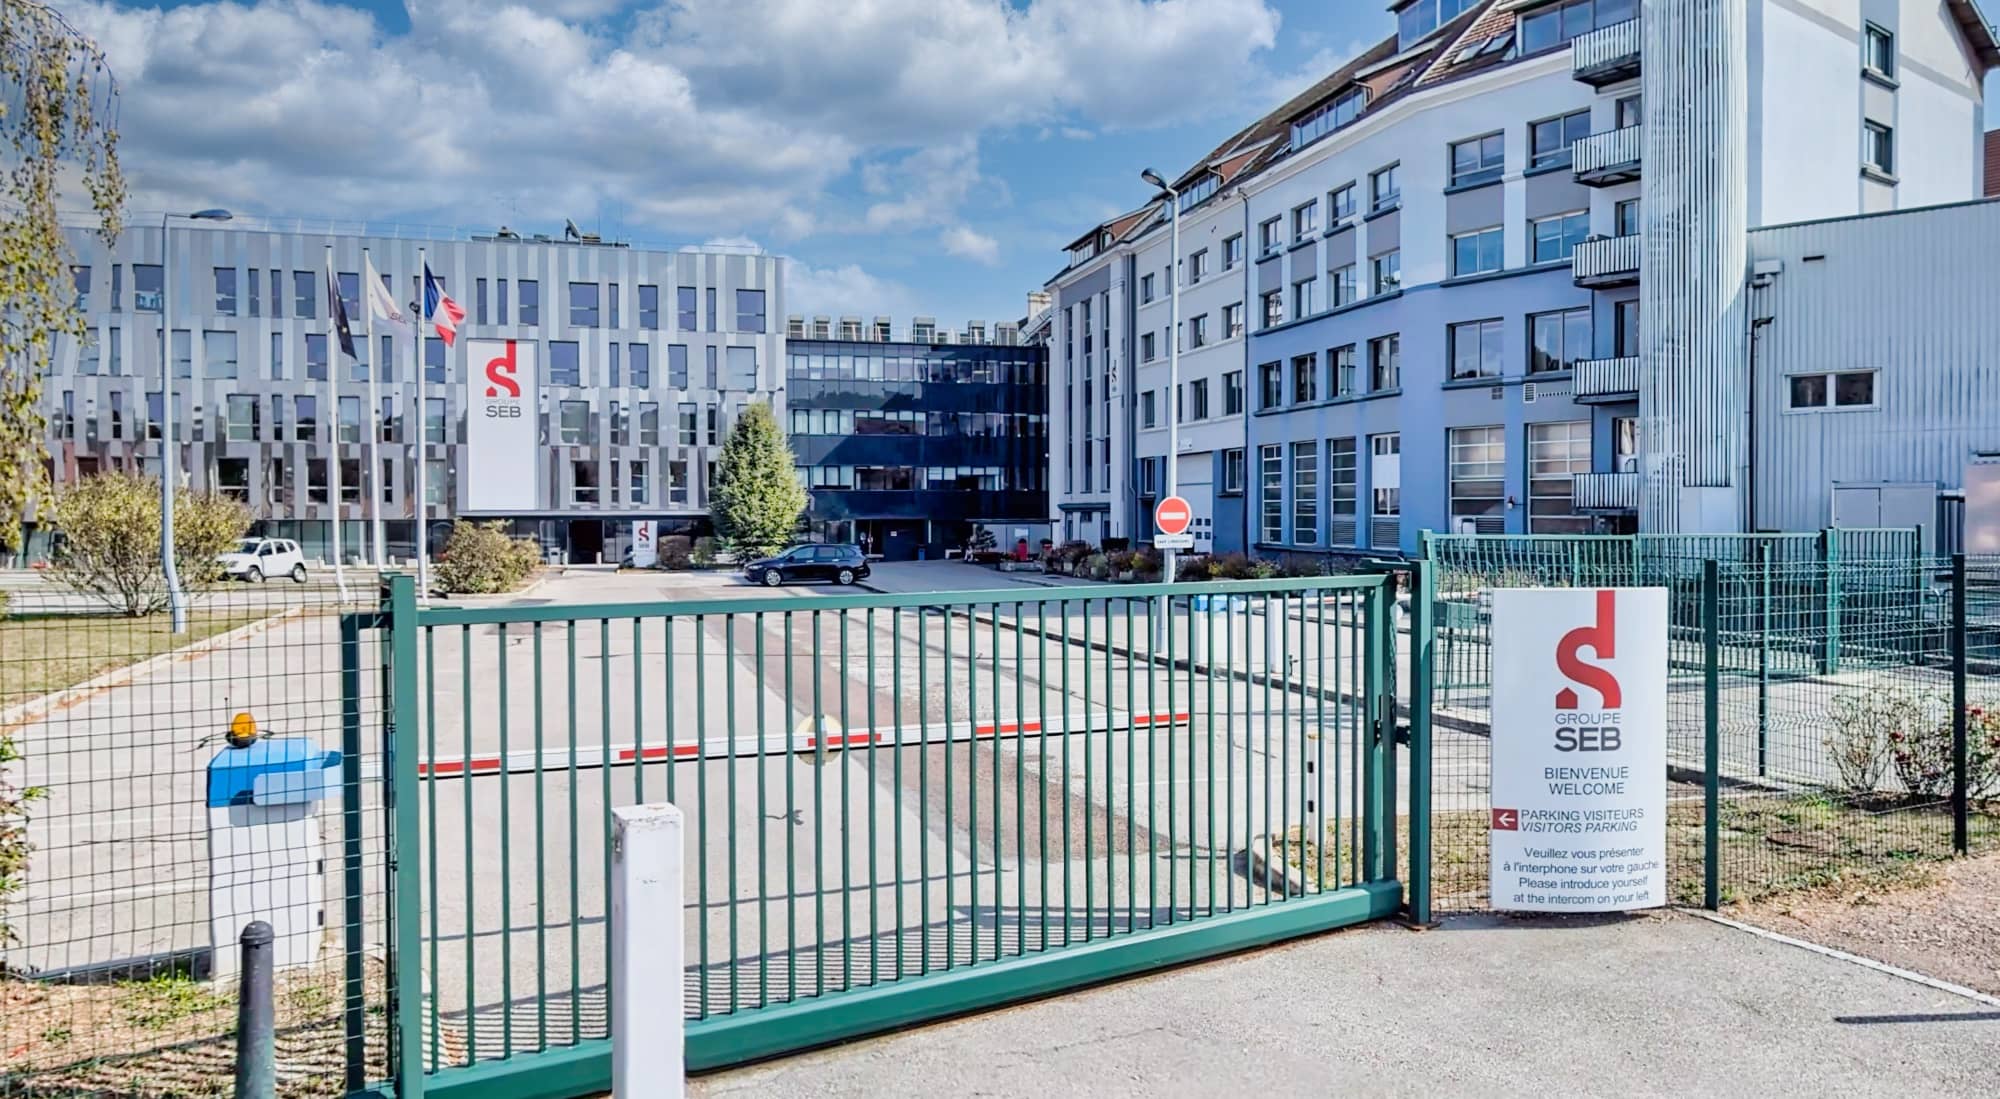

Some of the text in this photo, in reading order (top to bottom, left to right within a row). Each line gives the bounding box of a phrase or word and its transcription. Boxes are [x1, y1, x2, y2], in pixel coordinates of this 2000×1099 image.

[486, 405, 521, 418] SEB
[1555, 713, 1621, 725] GROUPE
[1554, 727, 1621, 752] SEB
[1544, 766, 1629, 780] BIENVENUE
[1549, 782, 1624, 795] WELCOME
[1521, 808, 1644, 821] PARKING VISITEURS
[1521, 821, 1638, 833] VISITORS PARKING
[1524, 847, 1644, 861] Veuillez vous présenter
[1503, 861, 1511, 872] à
[1580, 865, 1597, 874] sur
[1600, 864, 1625, 873] votre
[1627, 860, 1660, 875] gauche
[1519, 875, 1648, 891] Please introduce yourself
[1513, 890, 1649, 906] at the intercom on your left
